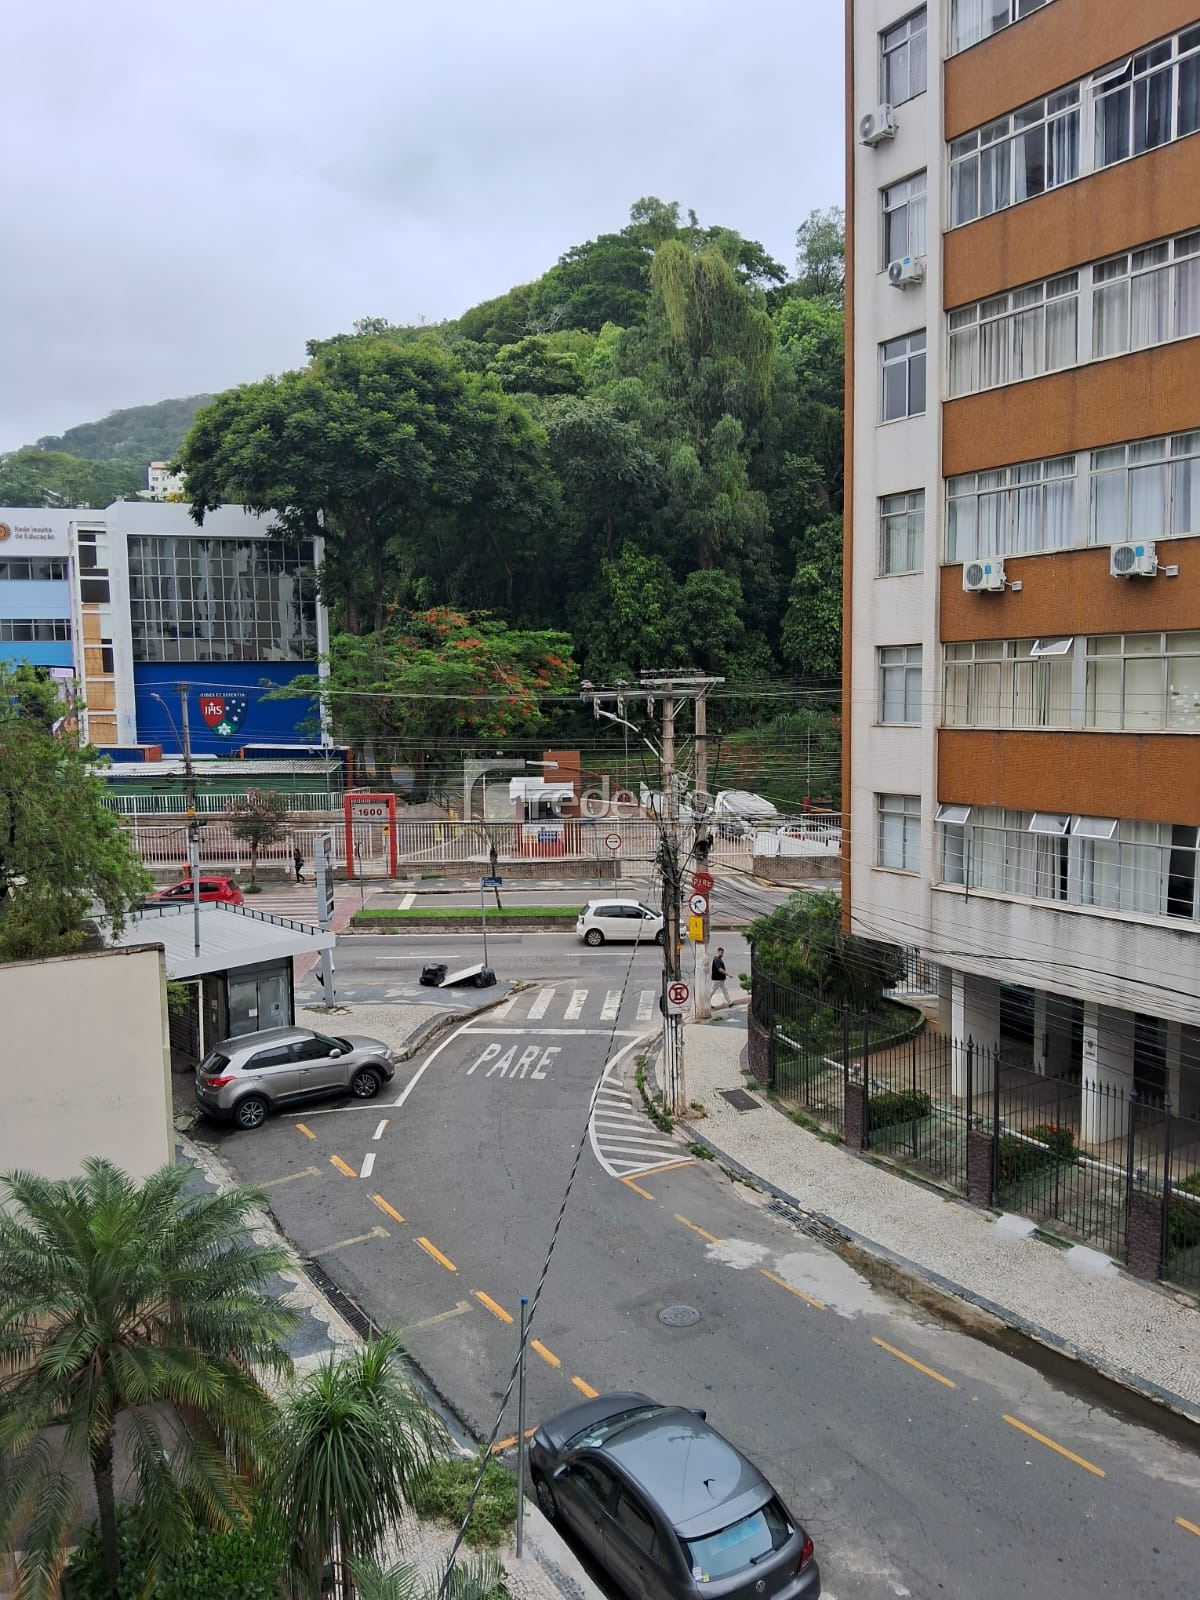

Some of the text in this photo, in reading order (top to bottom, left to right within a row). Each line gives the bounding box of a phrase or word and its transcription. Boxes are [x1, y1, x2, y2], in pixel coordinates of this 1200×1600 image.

[205, 702, 223, 715] IHS
[358, 808, 383, 816] 1600
[693, 878, 713, 888] PARE
[466, 1043, 562, 1080] PARE
